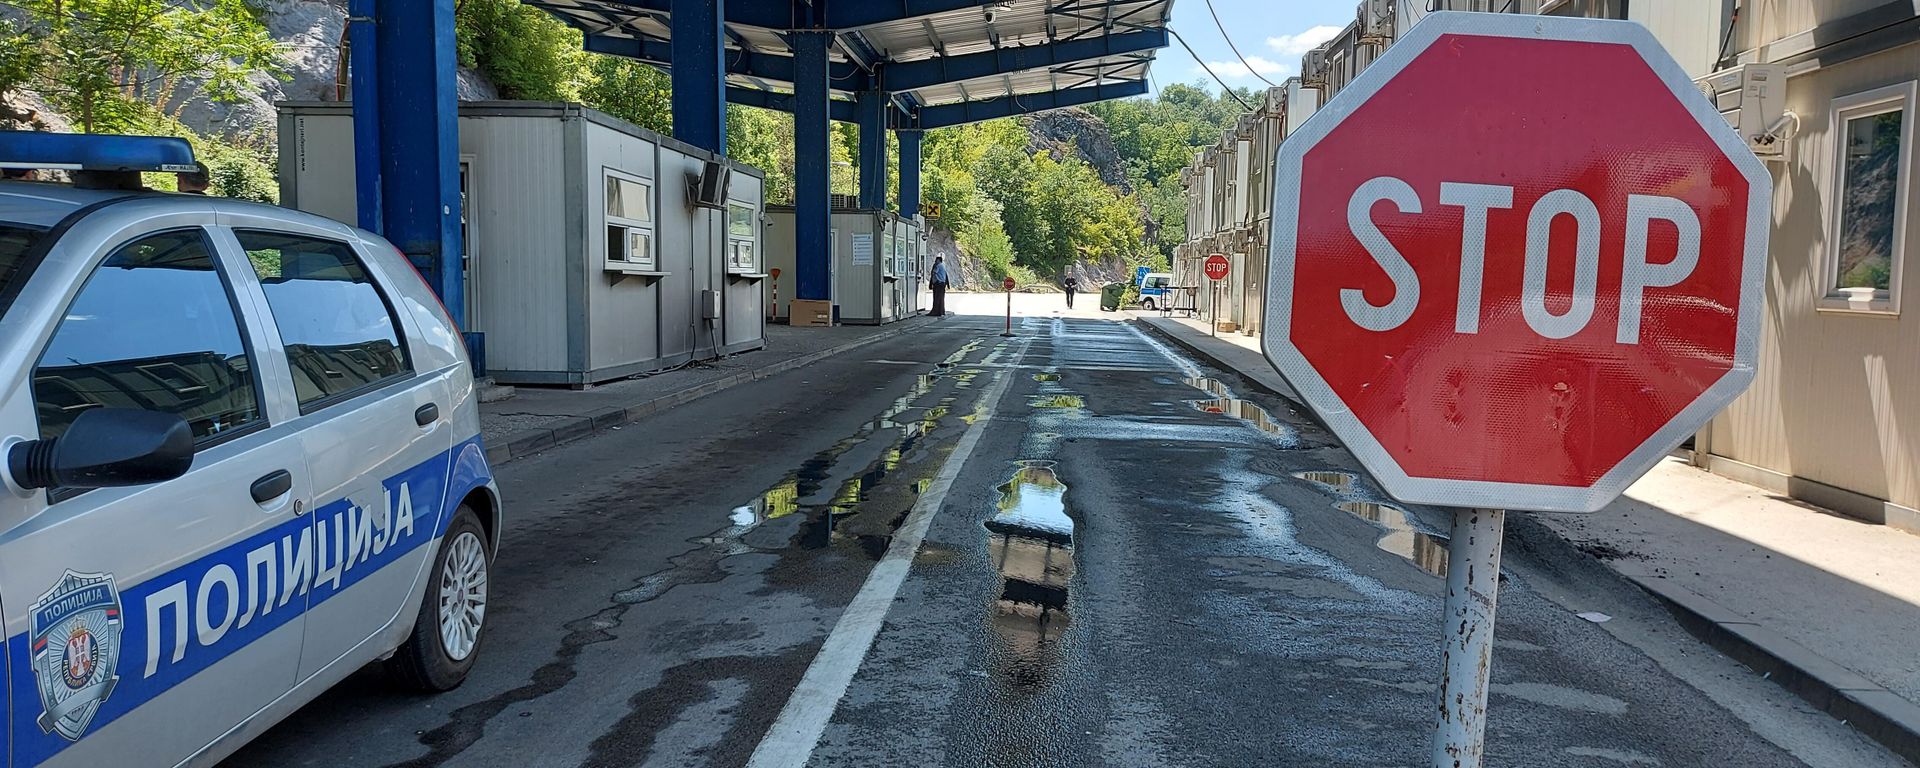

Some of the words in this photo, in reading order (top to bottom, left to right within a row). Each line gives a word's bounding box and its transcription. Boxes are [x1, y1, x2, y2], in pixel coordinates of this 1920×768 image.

[1207, 263, 1227, 272] STOP
[1340, 176, 1701, 345] STOP
[144, 481, 414, 679] ПОЛИЦИЈА
[45, 588, 103, 623] ПОЛИЦИЈА
[62, 659, 87, 687] РЕПУБЛИКА
